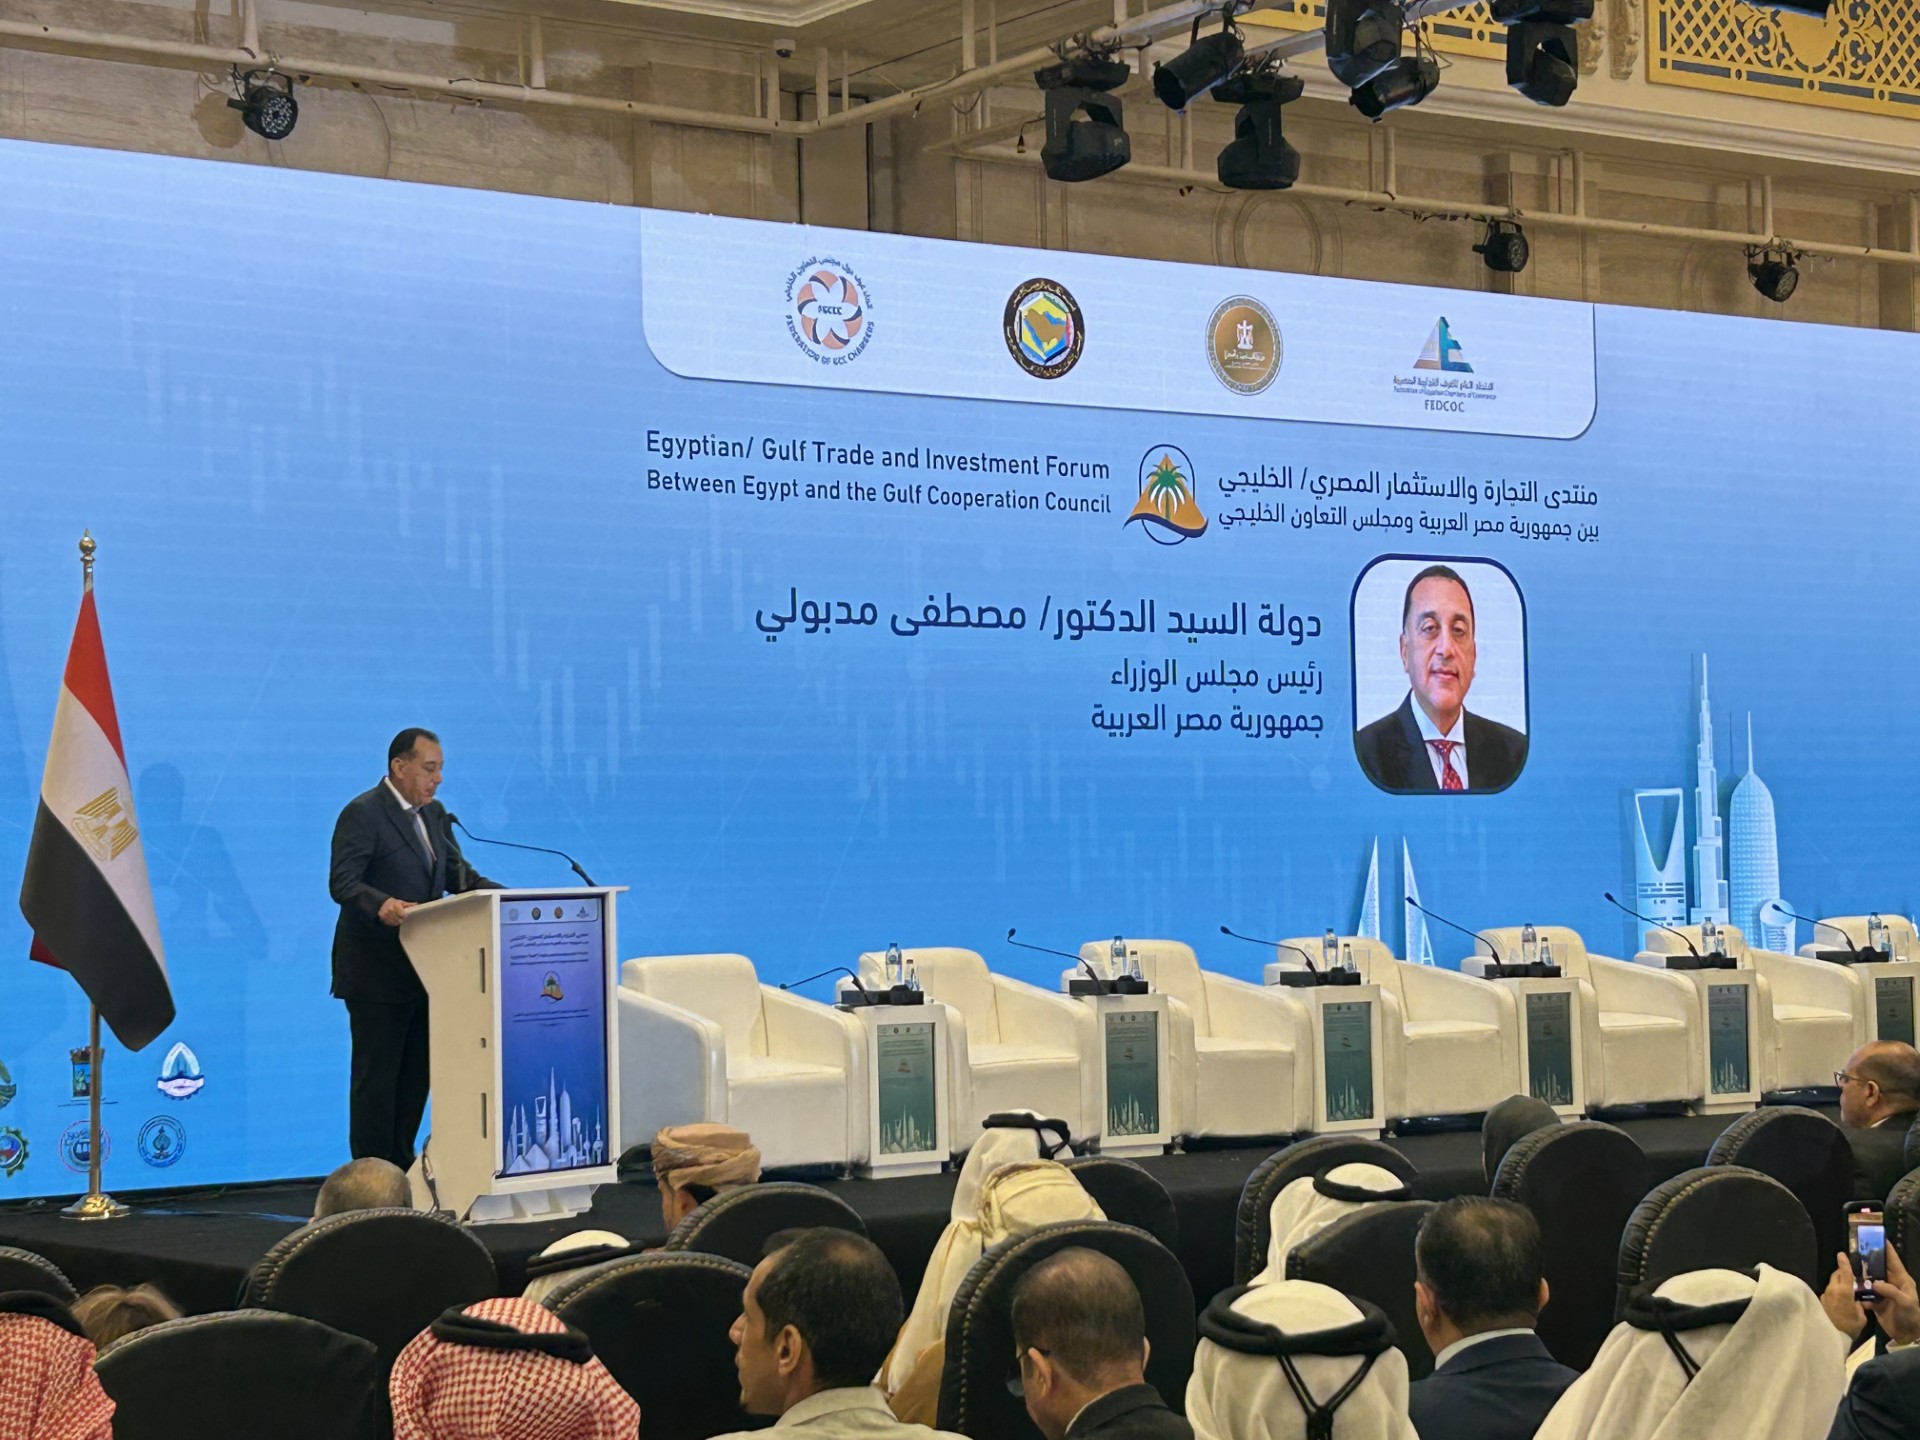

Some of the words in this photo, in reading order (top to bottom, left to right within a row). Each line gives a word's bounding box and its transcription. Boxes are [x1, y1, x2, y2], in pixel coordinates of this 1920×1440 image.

[1425, 399, 1465, 413] FEDCOC
[647, 430, 754, 460] Egyptian/
[762, 437, 807, 463] Gulf
[812, 440, 875, 468] Trade
[881, 446, 919, 469] and
[926, 447, 1040, 476] Investment
[1046, 455, 1110, 480] Forum
[647, 469, 736, 495] Between
[743, 474, 799, 503] Egypt
[804, 478, 841, 501] and
[846, 481, 877, 503] the
[883, 483, 922, 505] Gulf
[927, 485, 1039, 512] Cooperation
[1045, 491, 1112, 514] Council
[1218, 464, 1293, 498] الخليجي
[1386, 470, 1478, 506] والاستثمار
[1485, 478, 1538, 507] التجارة
[1543, 484, 1598, 510] منتدى
[1218, 501, 1285, 531] الخليجي
[1290, 503, 1347, 530] التعاون
[1353, 506, 1414, 534] ومجلس
[1419, 510, 1468, 536] العربية
[1472, 519, 1505, 538] مصر
[1509, 515, 1572, 541] جمهورية
[1577, 525, 1599, 543] بين
[755, 586, 878, 643] مدبولي
[890, 592, 1026, 637] مصطفى
[1167, 601, 1247, 644] السيد
[1258, 602, 1322, 646] دولة
[1110, 657, 1177, 693] الوزراء
[1185, 659, 1259, 695] مجلس
[1267, 660, 1323, 695] رئيس
[1091, 703, 1166, 738] العربية
[1174, 713, 1222, 739] مصر
[1230, 707, 1324, 739] جمهورية
